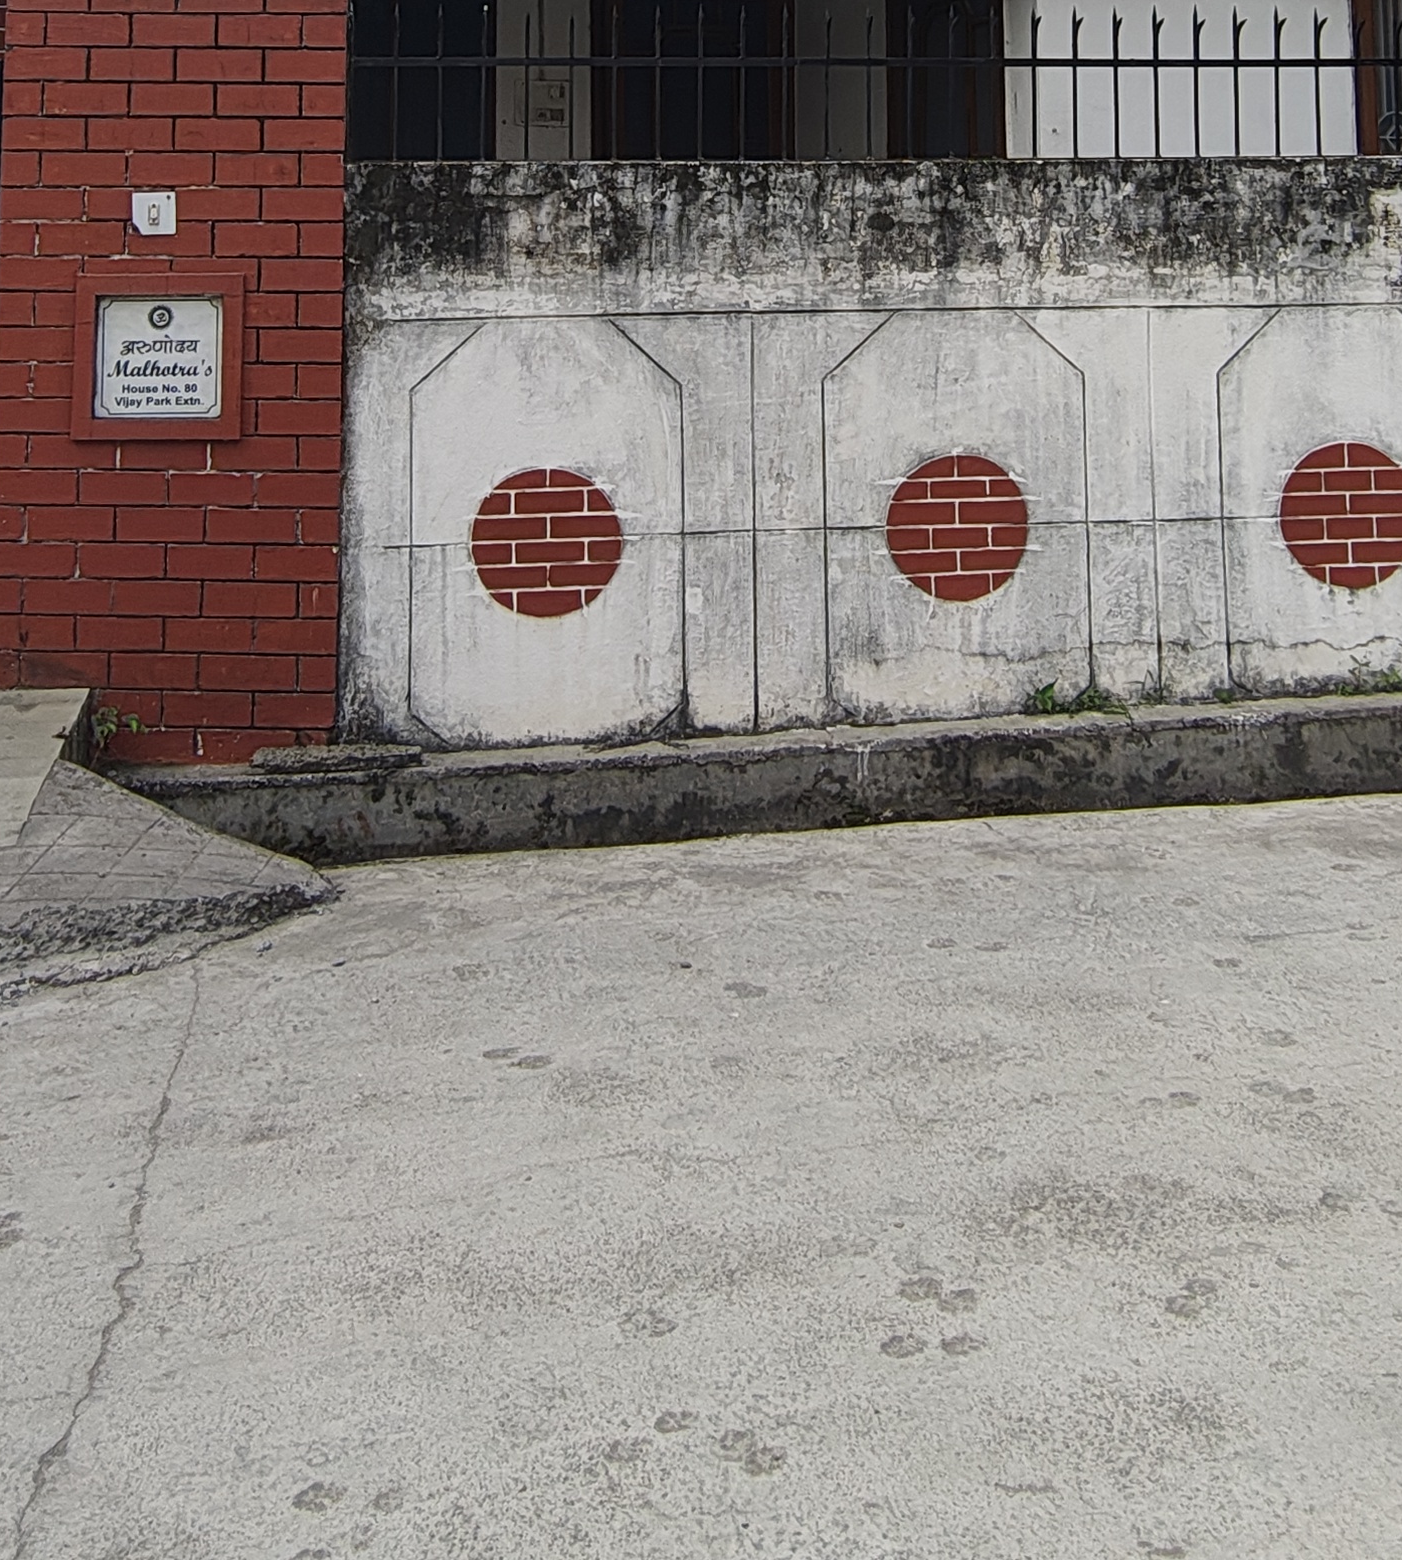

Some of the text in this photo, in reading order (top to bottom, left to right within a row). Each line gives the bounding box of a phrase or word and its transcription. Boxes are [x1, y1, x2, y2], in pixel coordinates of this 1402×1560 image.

[120, 334, 200, 356] अरुणोदय
[107, 359, 213, 378] Malhotra's
[122, 384, 197, 393] House No. 80
[115, 397, 204, 408] Vijay Park Extn.
